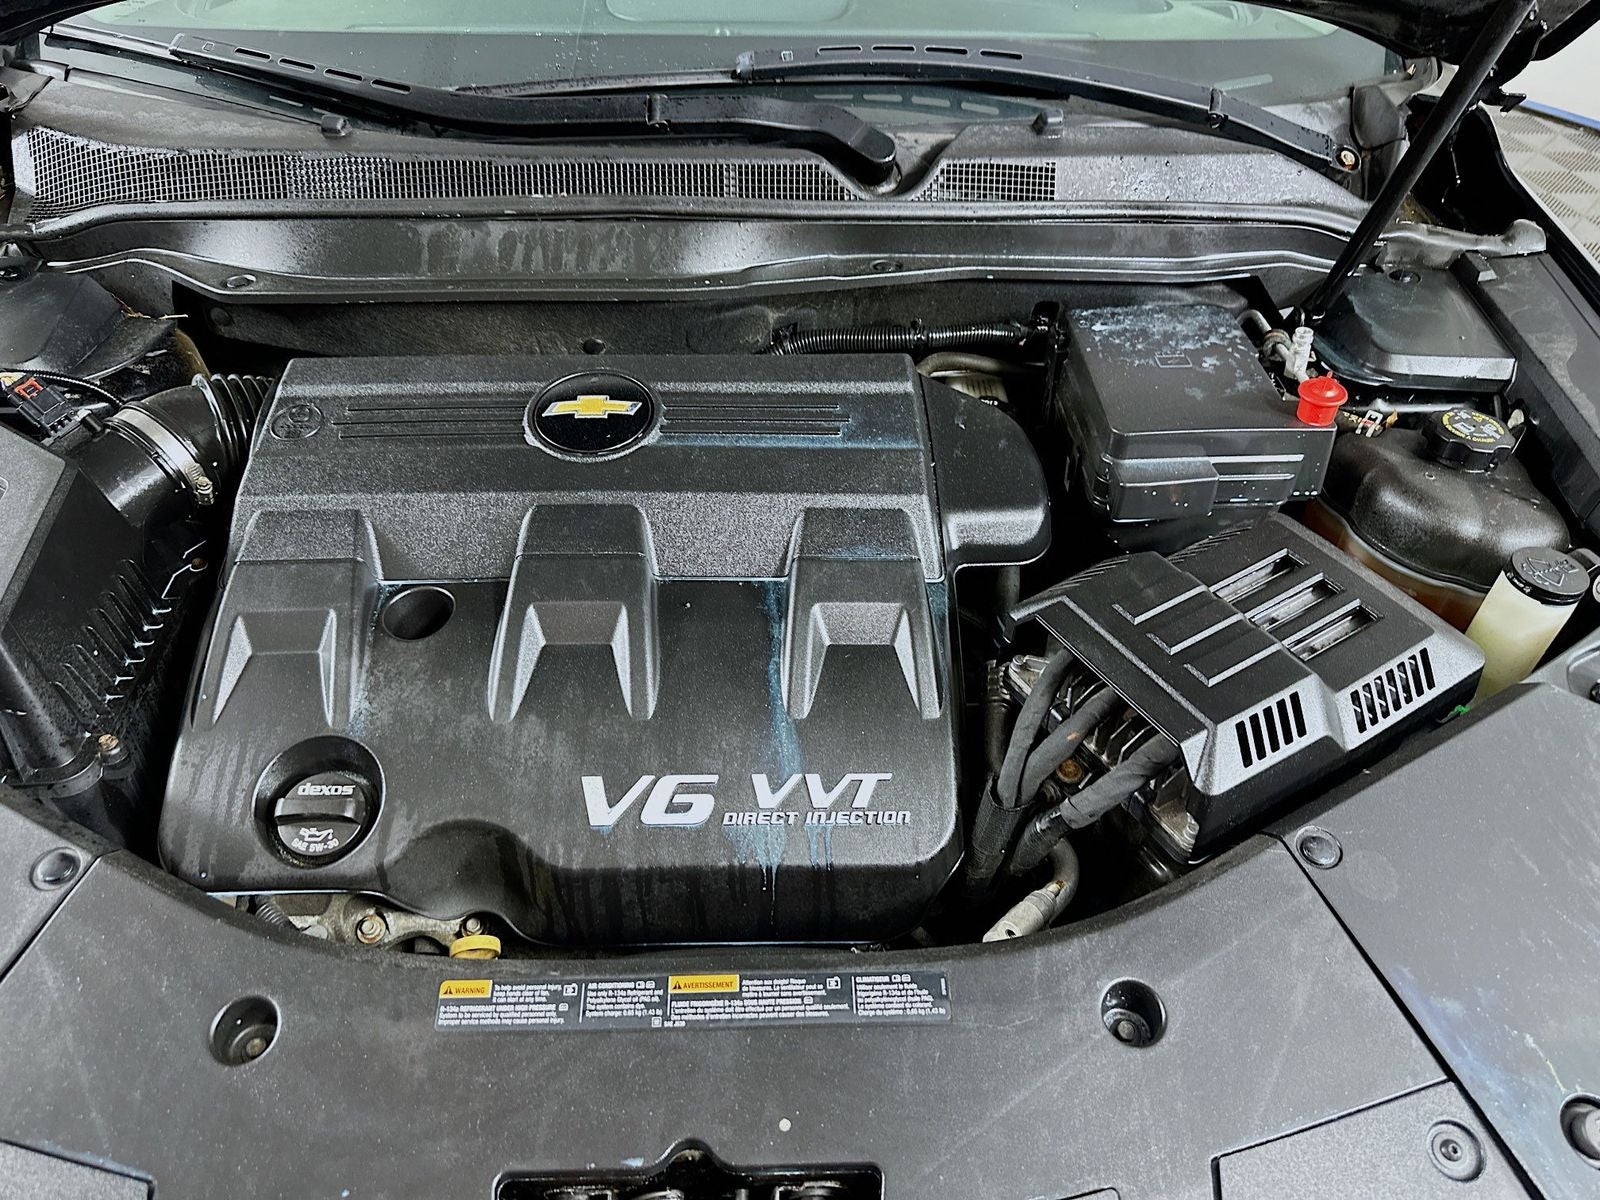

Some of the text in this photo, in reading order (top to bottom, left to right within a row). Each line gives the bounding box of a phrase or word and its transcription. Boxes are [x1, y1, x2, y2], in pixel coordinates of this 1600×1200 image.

[297, 782, 356, 796] dexos
[581, 775, 719, 826] V6
[751, 773, 892, 809] VVT
[722, 810, 911, 827] DIRECT INJECTION
